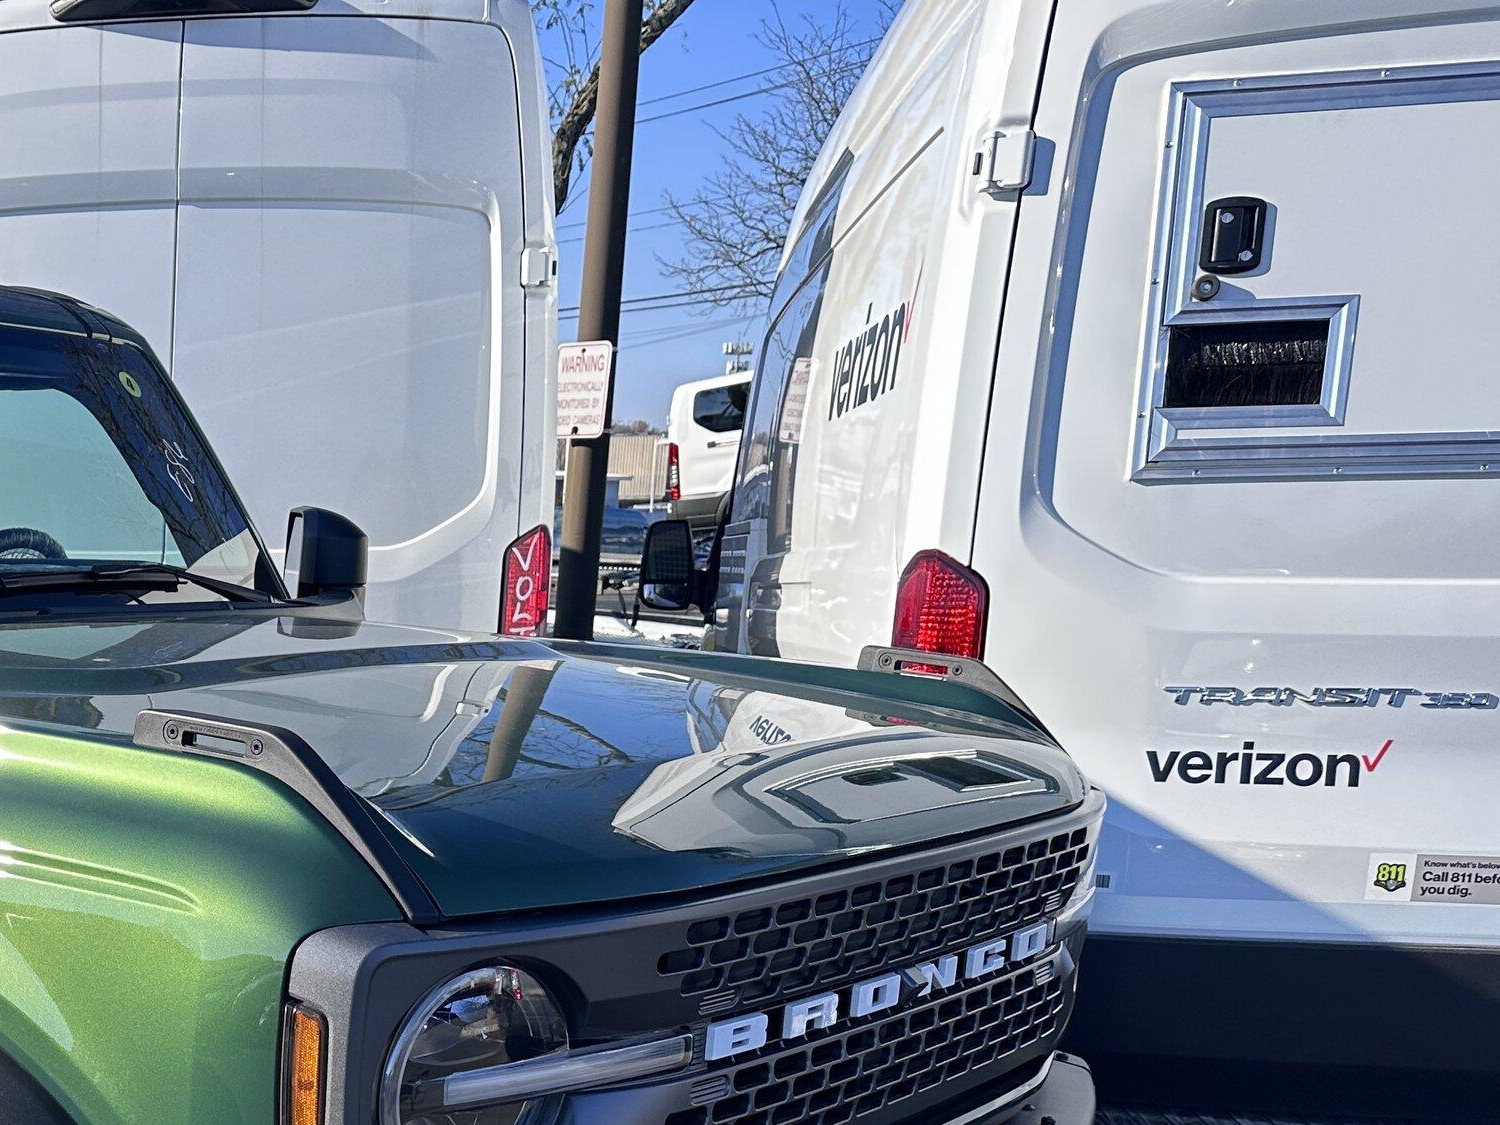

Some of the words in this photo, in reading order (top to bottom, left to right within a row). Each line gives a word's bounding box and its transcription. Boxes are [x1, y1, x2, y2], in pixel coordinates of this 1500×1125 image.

[561, 354, 605, 373] WARNING
[828, 302, 906, 422] verizon
[1163, 686, 1423, 708] TRANSIT
[1146, 741, 1361, 788] verizon
[1377, 863, 1406, 882] 811
[1423, 860, 1448, 868] Know
[1449, 860, 1477, 869] what's
[1422, 871, 1449, 882] Call
[1451, 872, 1473, 883] 811
[1420, 887, 1446, 897] you
[1447, 885, 1473, 898] dig.
[704, 922, 1049, 1062] BRONCO
